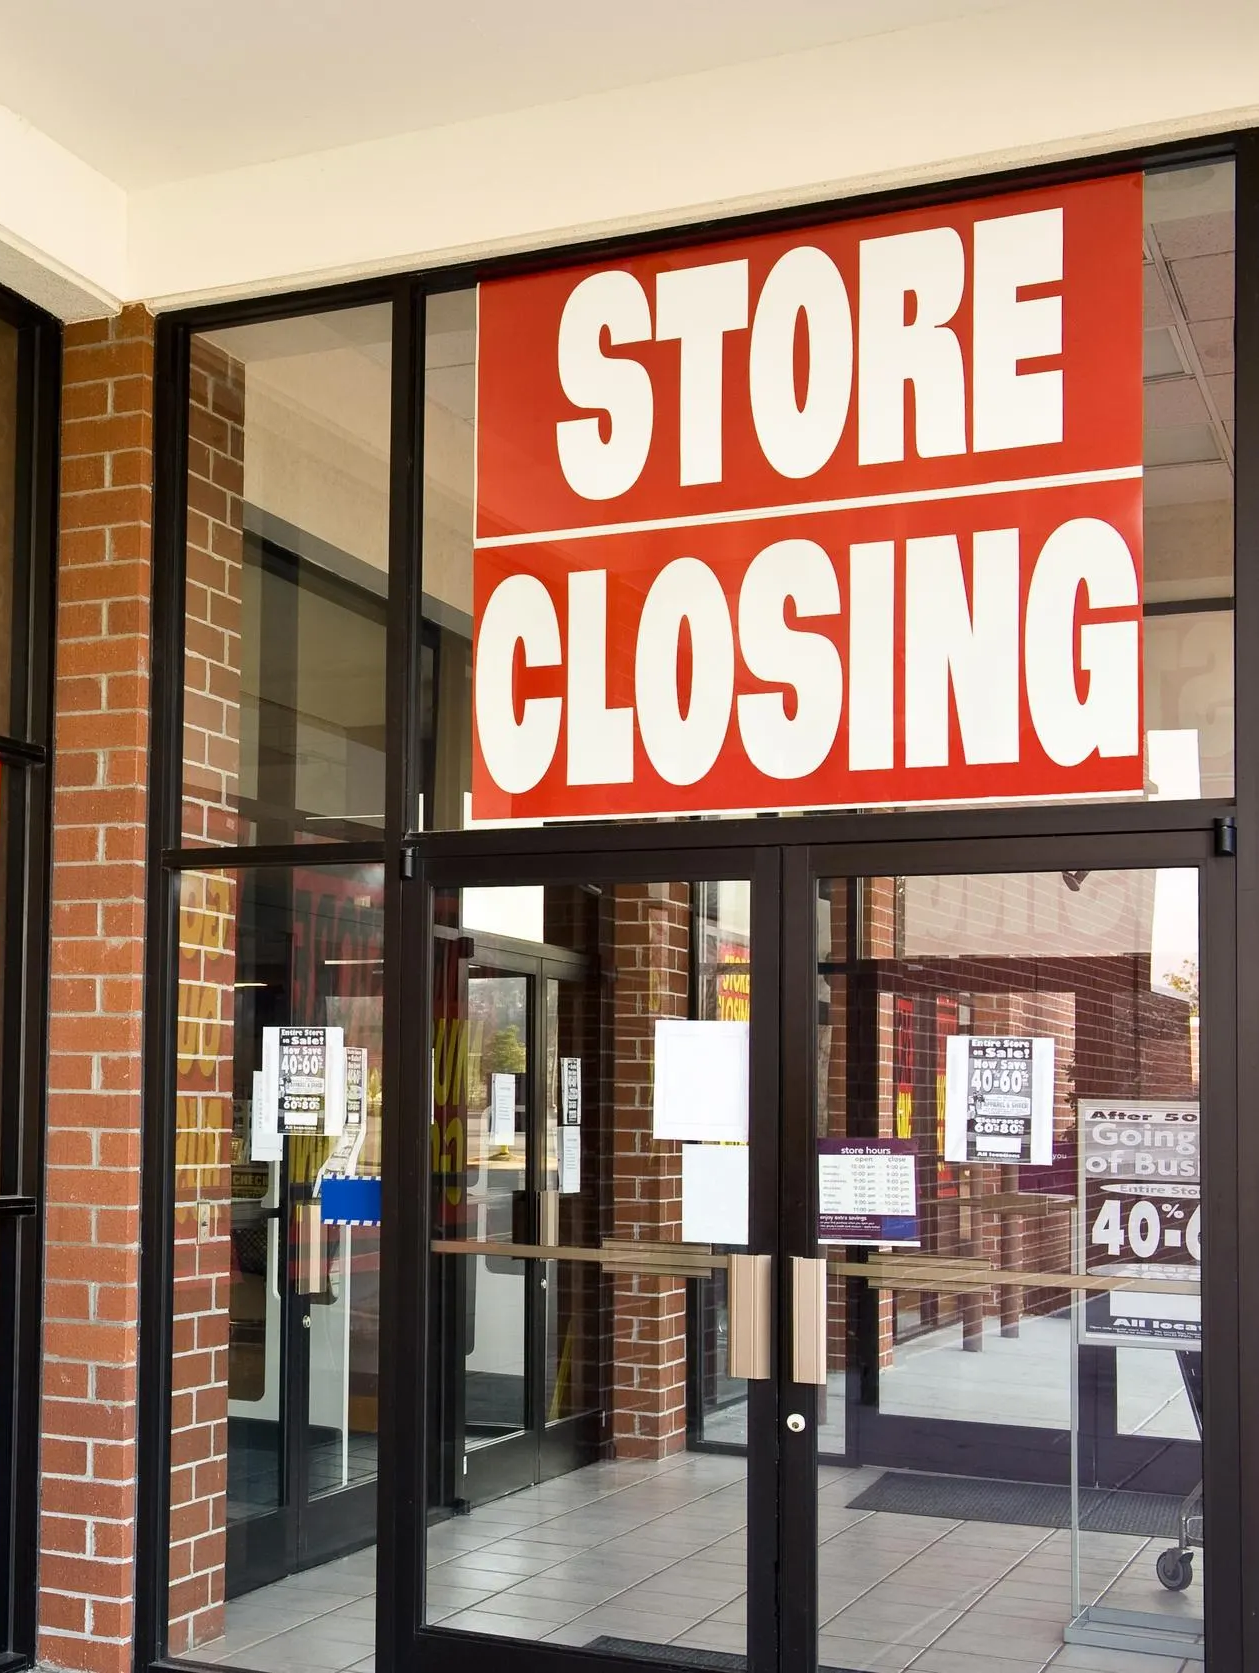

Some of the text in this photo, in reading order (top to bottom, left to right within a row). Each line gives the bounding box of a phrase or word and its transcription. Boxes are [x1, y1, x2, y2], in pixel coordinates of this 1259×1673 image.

[556, 207, 1064, 500] STORE
[475, 517, 1139, 794] CLOSING
[291, 1037, 324, 1045] Sale!
[971, 1039, 1030, 1048] Entire Store
[302, 1046, 322, 1055] Save
[985, 1048, 1030, 1058] Sale!
[973, 1059, 1027, 1070] Now Save
[1090, 1111, 1198, 1122] After 50
[1092, 1122, 1196, 1155] Going
[865, 1146, 891, 1154] hours
[1086, 1150, 1200, 1177] of Bus
[1120, 1184, 1200, 1195] Entire Sto
[1113, 1318, 1146, 1328] All
